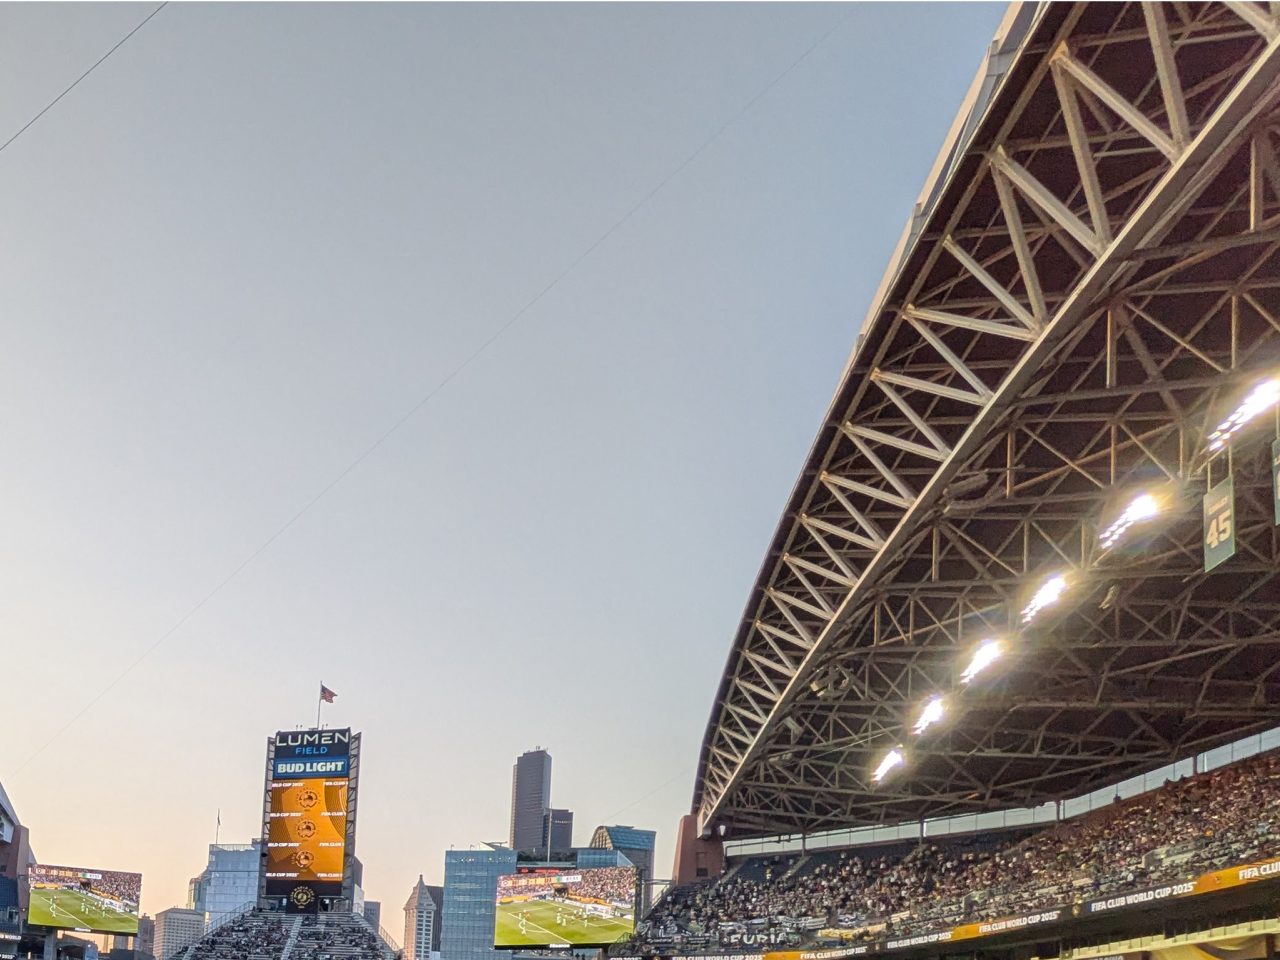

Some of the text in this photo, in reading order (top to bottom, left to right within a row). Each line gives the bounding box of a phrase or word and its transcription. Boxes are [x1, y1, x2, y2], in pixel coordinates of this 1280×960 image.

[1206, 509, 1231, 549] 45
[276, 732, 350, 747] LUMEN
[295, 747, 328, 755] FIELD
[277, 761, 345, 773] BUD LIGHT
[1239, 868, 1259, 880] FIFA
[1091, 902, 1106, 912] FIFA
[1108, 898, 1126, 909] CLUB
[1126, 891, 1154, 905] WORLD
[1155, 888, 1171, 900] CUP
[979, 923, 991, 934] FIFA
[991, 921, 1006, 932] CLUB
[1006, 917, 1027, 930] WORLD
[1027, 915, 1040, 926] CUP
[887, 940, 897, 949] FIFA
